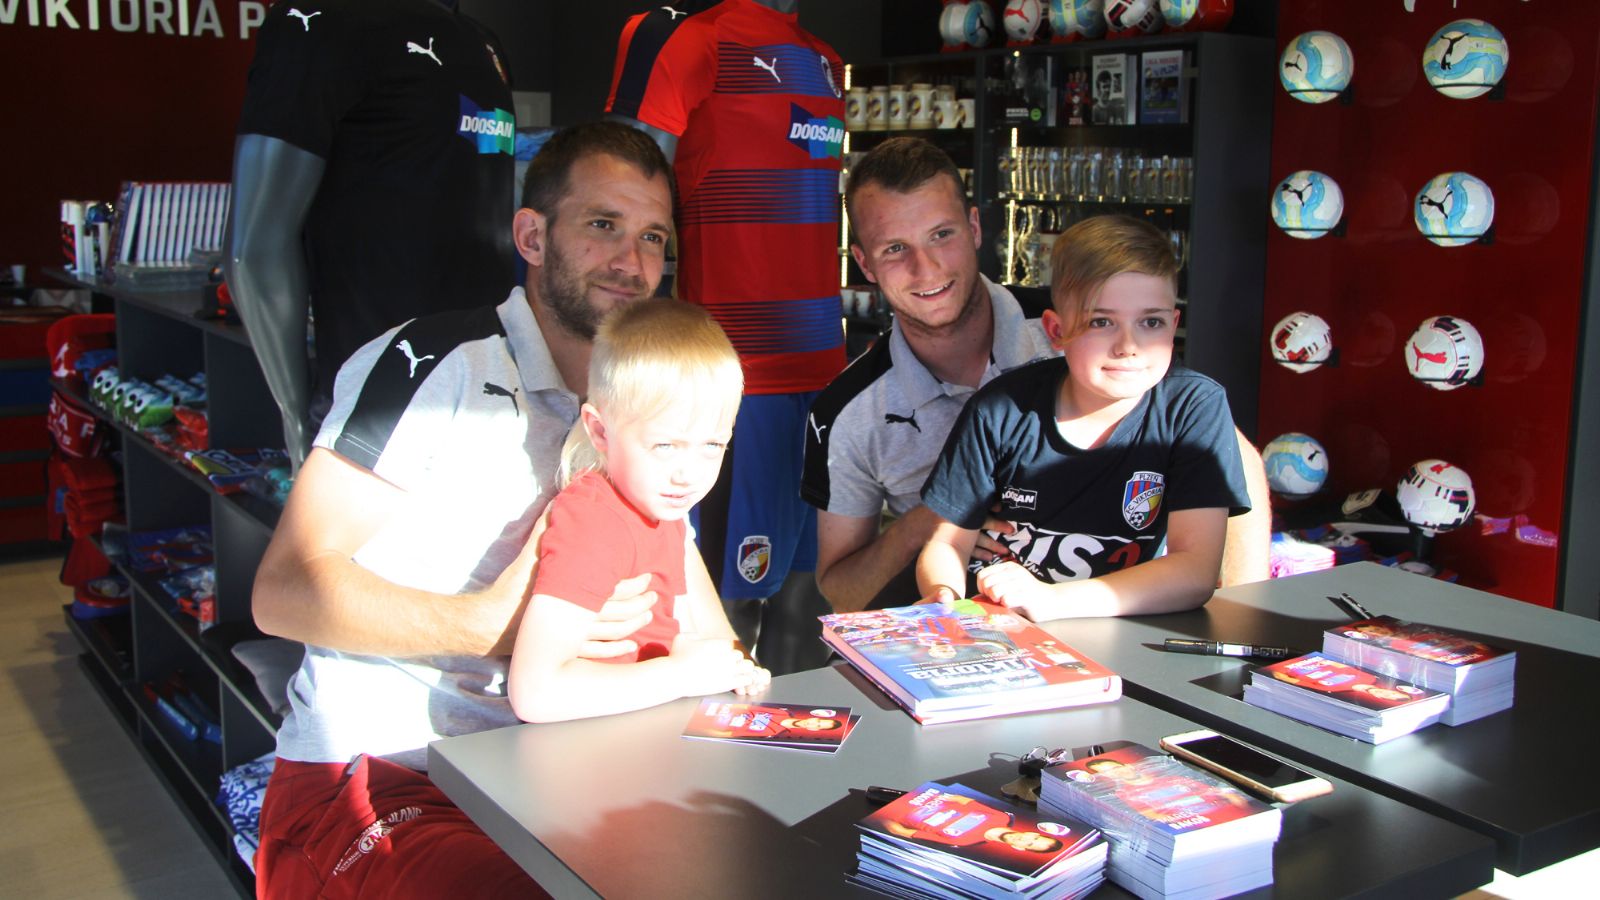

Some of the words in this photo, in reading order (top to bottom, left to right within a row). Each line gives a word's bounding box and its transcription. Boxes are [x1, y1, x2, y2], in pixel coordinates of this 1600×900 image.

[460, 115, 513, 138] DOOSAN
[789, 122, 845, 144] DOOSAN
[1133, 487, 1162, 505] VIKTORIA
[904, 656, 1051, 681] Viktoria
